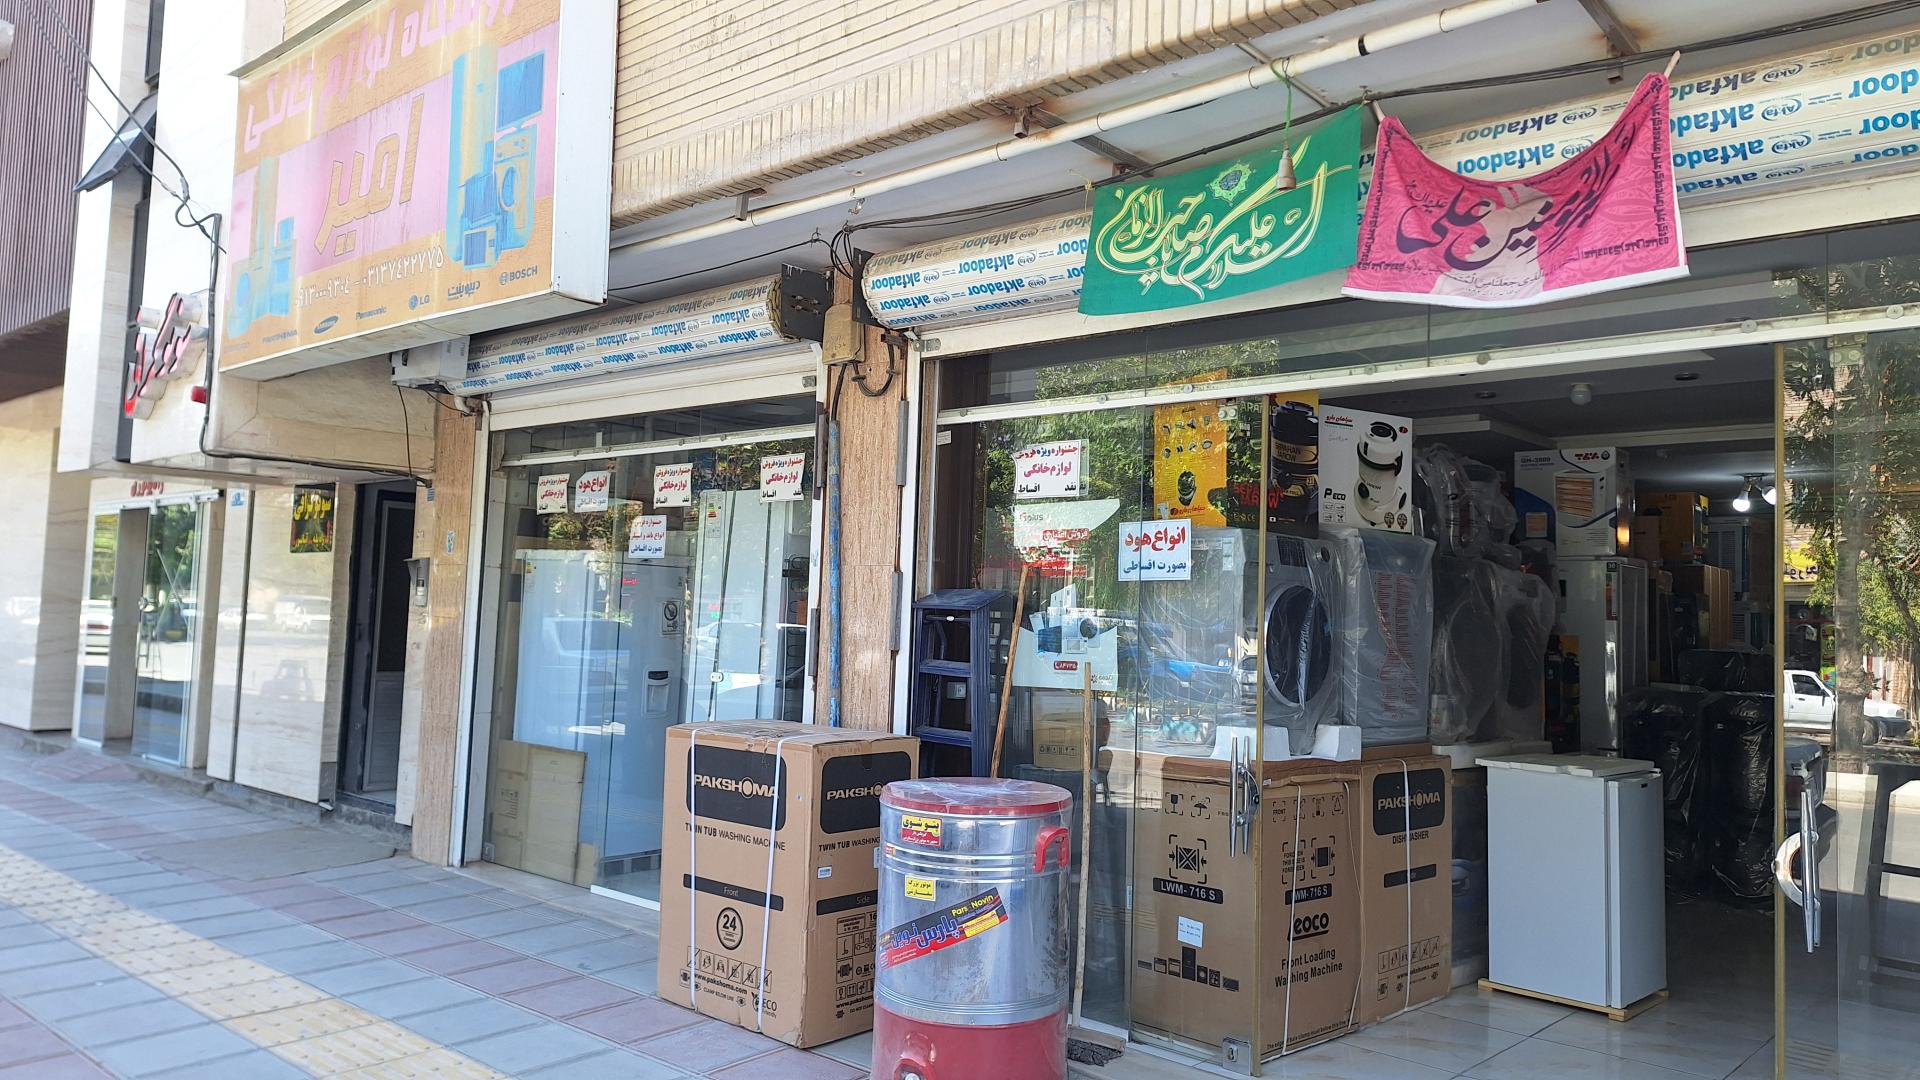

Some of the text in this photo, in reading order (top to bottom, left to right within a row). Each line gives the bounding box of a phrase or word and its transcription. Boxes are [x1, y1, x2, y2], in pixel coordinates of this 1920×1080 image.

[1851, 34, 1920, 60] door
[1669, 70, 1757, 101] akfado
[1849, 68, 1920, 98] door
[1456, 113, 1558, 144] akfadoor
[1670, 103, 1755, 137] akfad
[1859, 110, 1920, 135] door
[1456, 143, 1556, 175] akfadoor
[1673, 139, 1764, 169] akfado
[314, 92, 426, 257] امیر
[1677, 143, 1920, 193] door akfad
[960, 231, 1017, 249] akfadoor
[959, 254, 1015, 274] akfadoor
[509, 265, 538, 281] BOSCH
[870, 272, 921, 290] akfadoor
[967, 277, 1025, 297] akfadoor
[880, 294, 931, 311] akfadoor
[973, 298, 1031, 312] akfadoor
[711, 309, 750, 324] akfadoor
[651, 321, 686, 337] akfadoor
[717, 330, 758, 344] akfadoor
[595, 333, 628, 347] akfadoor
[657, 340, 694, 354] akfadoor
[544, 343, 575, 357] akfadoor
[601, 351, 637, 364] akfadoor
[550, 361, 582, 373] akfadoor
[1016, 445, 1078, 460] جشنواره ویژه فروش
[762, 460, 776, 469] فروش
[785, 456, 804, 467] جشنواره
[1023, 461, 1072, 478] لوازم خانگی
[579, 476, 607, 493] انواع هود
[658, 481, 687, 492] لوازم خانگی
[766, 471, 799, 485] لوازم خانگی
[762, 488, 802, 498] نقد اقساط
[1018, 481, 1077, 493] نقد اقساط
[1324, 488, 1347, 501] P ECO
[1123, 526, 1186, 553] انواع هود
[1122, 559, 1187, 575] بصورت اقساطی
[694, 774, 778, 799] PAKSHOMA
[826, 783, 885, 802] PAKSHO
[1377, 791, 1441, 811] PAKSHOMA
[902, 817, 923, 829] شوی
[704, 825, 717, 838] TUB
[718, 829, 752, 845] WASHING
[1393, 831, 1429, 845] DISHASHER
[819, 836, 881, 852] TWIN TUB WASHING
[723, 886, 740, 898] Front
[856, 895, 870, 905] Side
[951, 905, 968, 917] Pars
[971, 894, 994, 908] Novin
[722, 913, 737, 932] 24
[891, 922, 919, 949] نوین
[917, 916, 960, 949] پارس
[1281, 948, 1336, 971] Front Loading
[1275, 962, 1343, 988] Wahing Machine
[762, 998, 778, 1012] ECO
